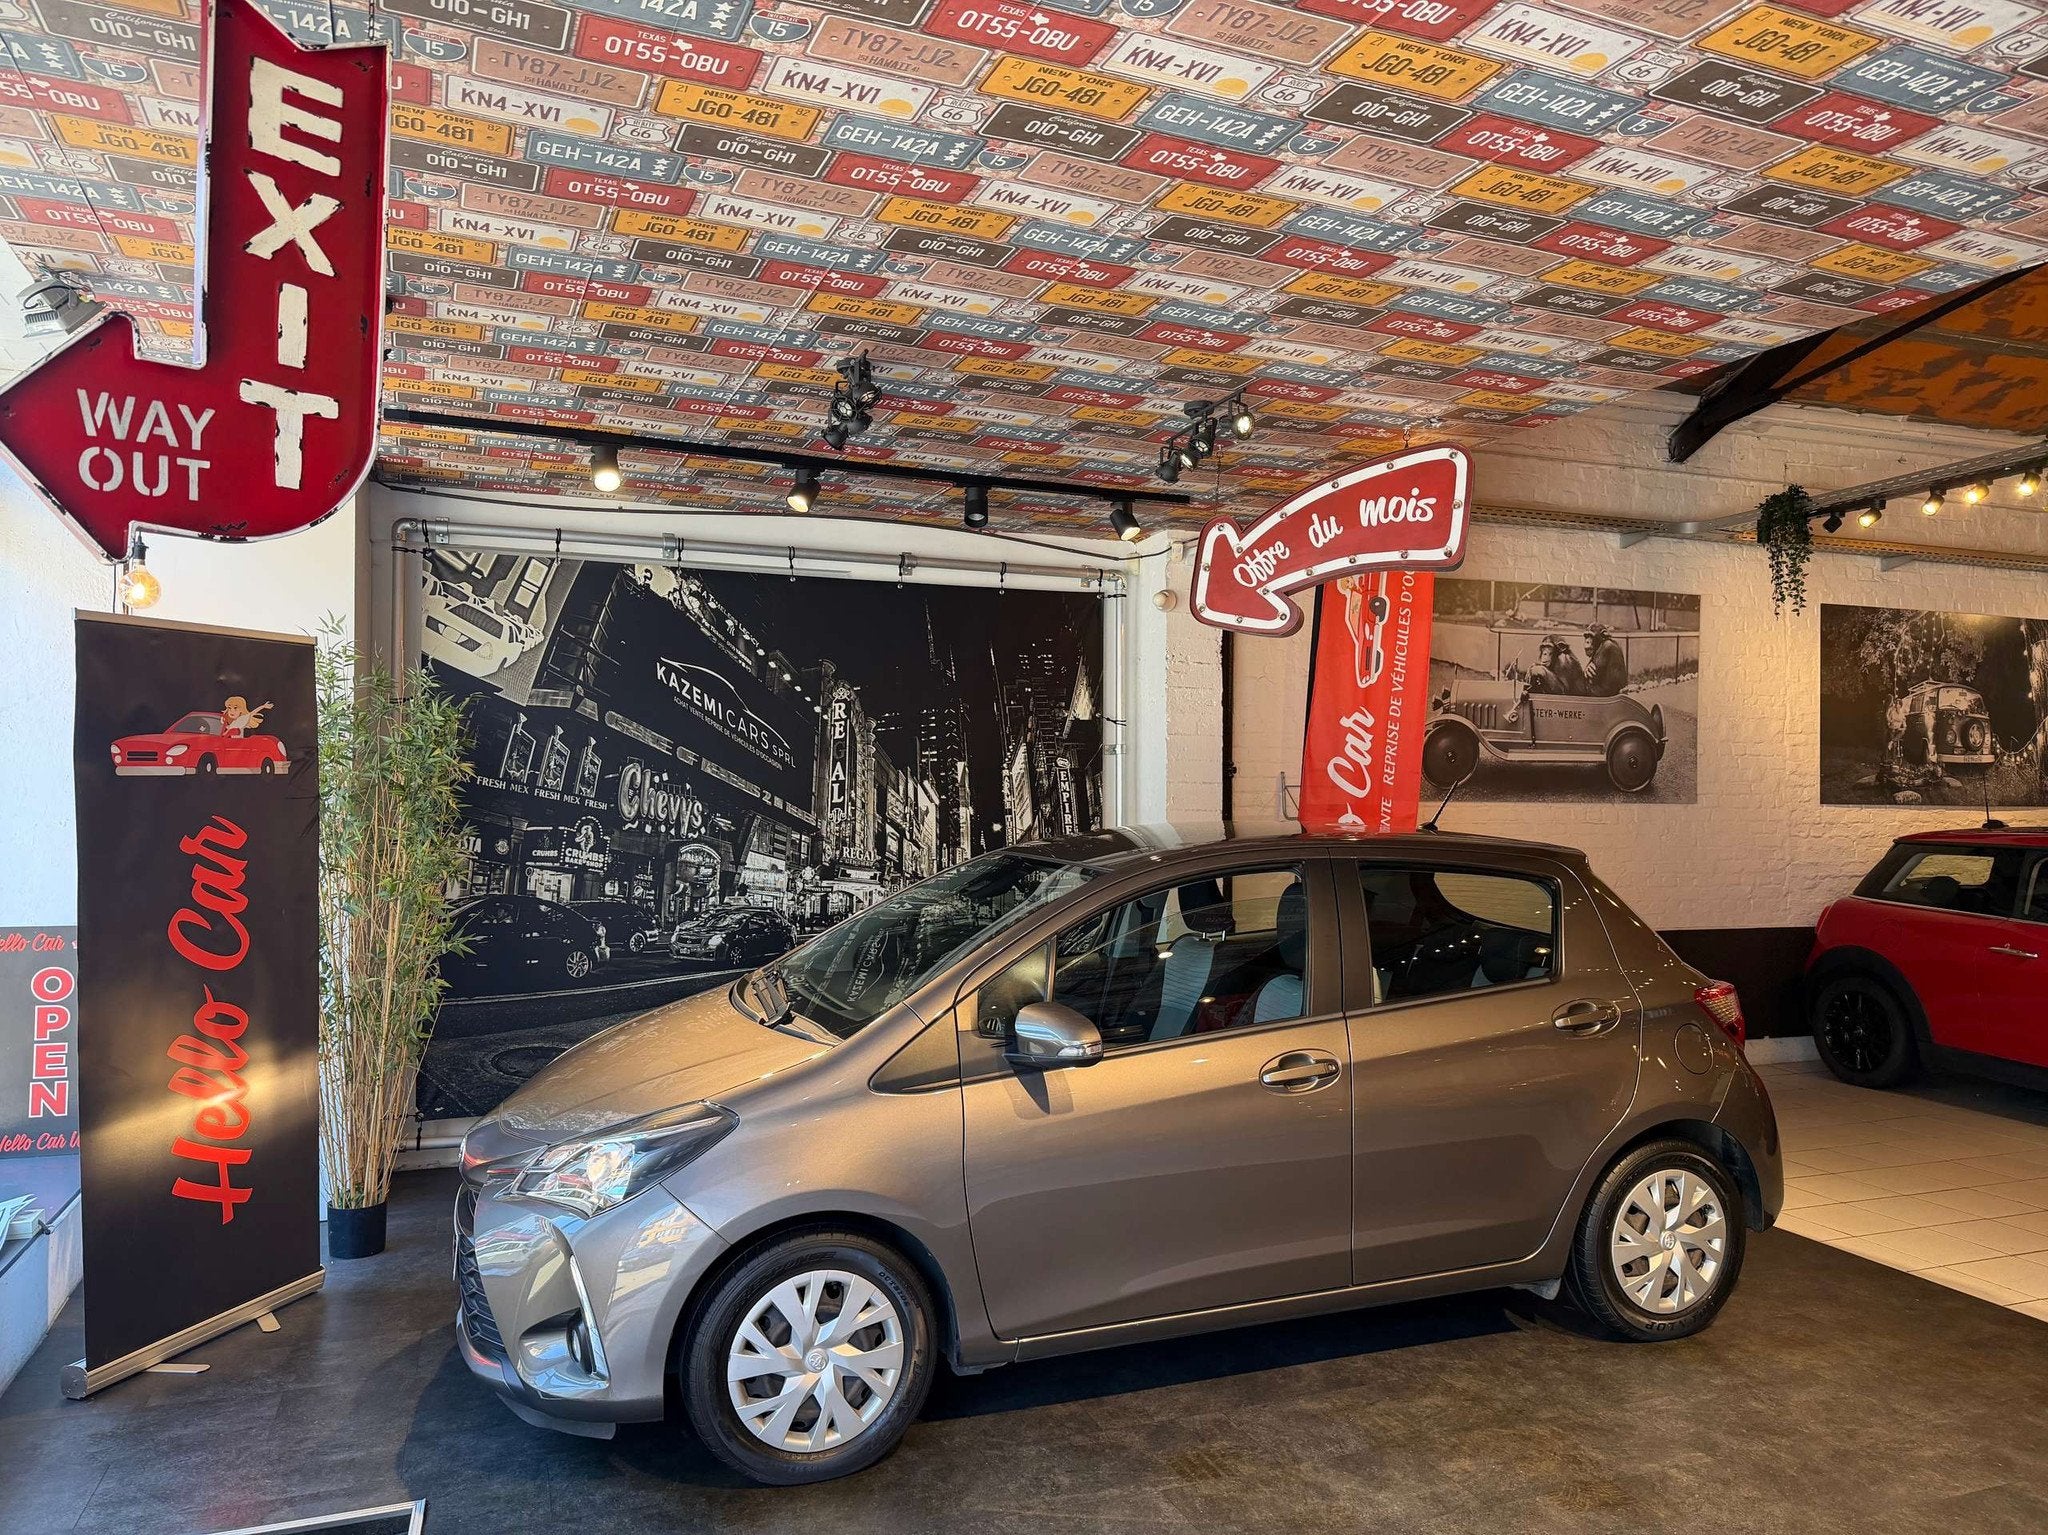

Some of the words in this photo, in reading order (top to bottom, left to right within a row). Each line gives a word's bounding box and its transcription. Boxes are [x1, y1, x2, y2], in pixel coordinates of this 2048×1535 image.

[998, 4, 1026, 16] TEXAS
[638, 31, 666, 42] TEXAS
[767, 22, 789, 36] 15
[1779, 17, 1813, 31] NEW
[1813, 25, 1849, 42] YORK
[422, 41, 446, 56] 15
[1396, 43, 1430, 55] NEW
[1435, 49, 1470, 66] YORK
[102, 63, 126, 78] 15
[1038, 67, 1074, 78] NEW
[1079, 74, 1115, 88] YORK
[704, 89, 739, 100] NEW
[746, 96, 785, 110] YORK
[1510, 127, 1536, 137] TEXAS
[1629, 119, 1651, 132] 15
[990, 155, 1007, 167] 15
[1186, 146, 1209, 155] TEXAS
[239, 56, 345, 490] EXIT
[76, 388, 216, 451] WAY
[77, 446, 211, 502] OUT
[1233, 540, 1290, 588] Offre
[1308, 513, 1344, 549] du
[1359, 487, 1438, 528] mois
[1391, 607, 1411, 692] VÉHICULES
[1389, 696, 1402, 718] DE
[772, 744, 797, 769] SPRL
[1327, 706, 1375, 798] Car
[1383, 720, 1400, 786] REPRISE
[476, 775, 507, 790] FRESH
[509, 782, 529, 795] MEX
[534, 788, 561, 801] FRESH
[563, 794, 581, 805] MEX
[584, 799, 608, 811] FRESH
[618, 762, 703, 838] Chevys
[1060, 770, 1074, 836] EMPIRE
[565, 848, 604, 862] CRUMBS
[168, 814, 250, 971] Car
[0, 933, 30, 952] ello
[32, 932, 65, 952] Car
[29, 966, 75, 1118] OPEN
[168, 983, 253, 1225] Hello
[36, 1132, 66, 1150] Car
